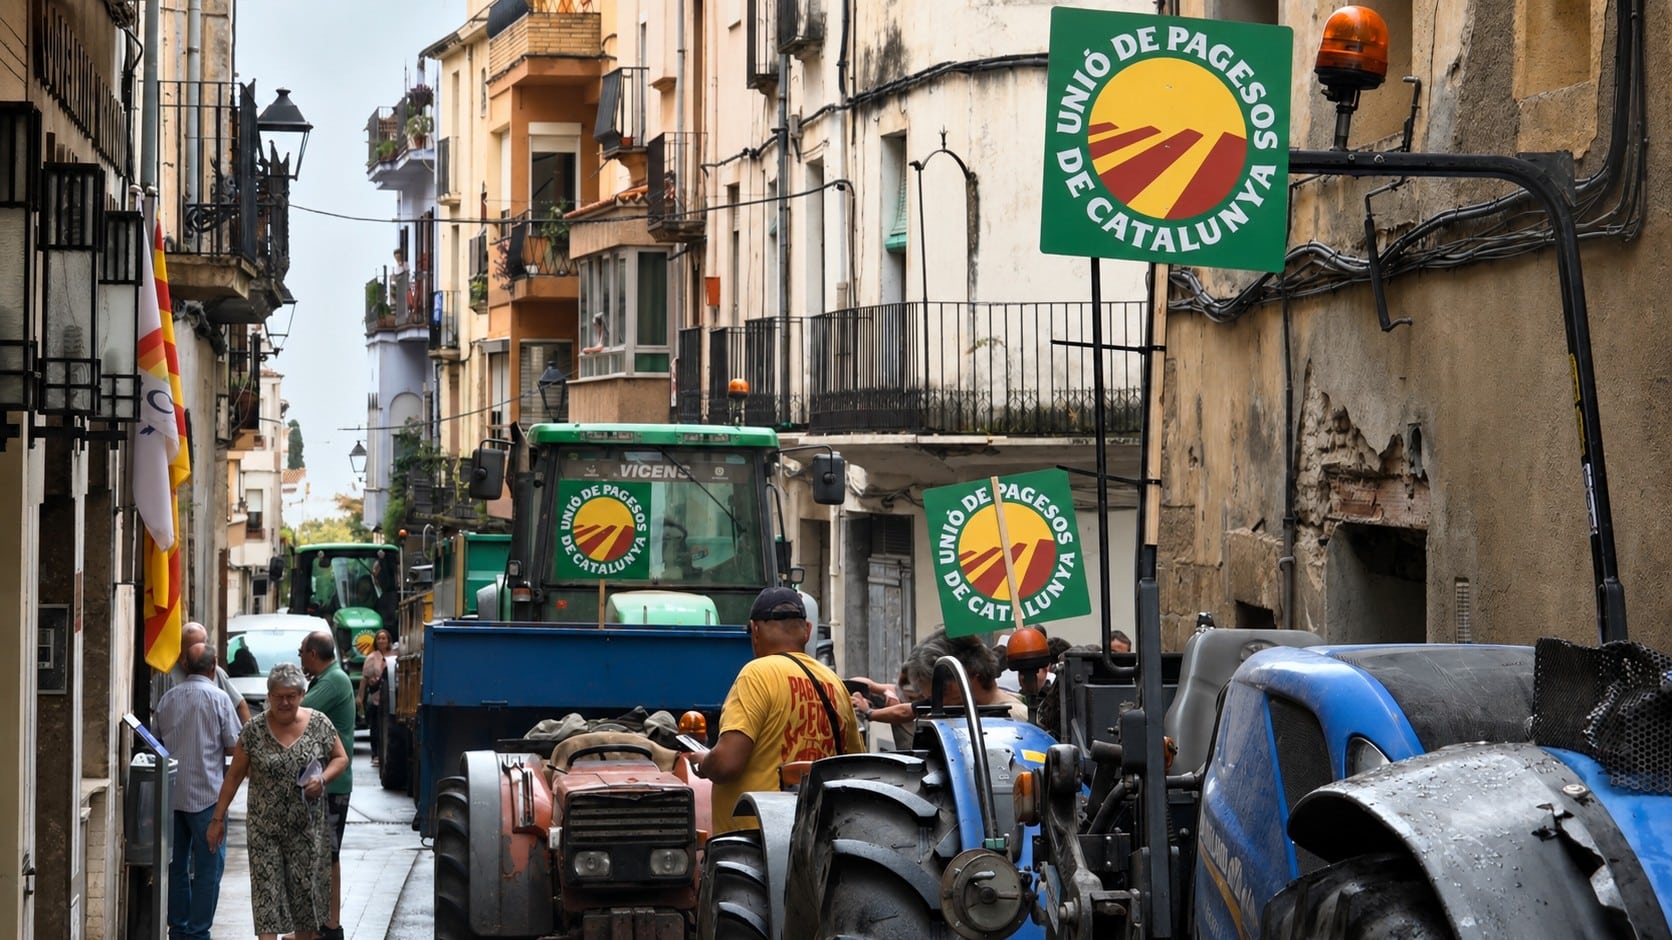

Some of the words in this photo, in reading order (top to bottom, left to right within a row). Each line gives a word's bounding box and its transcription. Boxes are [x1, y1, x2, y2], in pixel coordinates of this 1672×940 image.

[1056, 48, 1111, 134] UNIÓ
[1110, 26, 1160, 61] DE
[1167, 26, 1279, 150] PAGESOS
[1056, 147, 1096, 198] DE
[1086, 164, 1277, 253] CATALUNYA
[561, 496, 581, 530] UNIÓ
[582, 485, 600, 500] DE
[603, 485, 646, 531] PAGESOS
[939, 509, 965, 565] UNIÓ
[961, 487, 992, 512] DE
[561, 535, 576, 555] DE
[573, 536, 646, 574] CATALUNYA
[943, 570, 971, 601] DE
